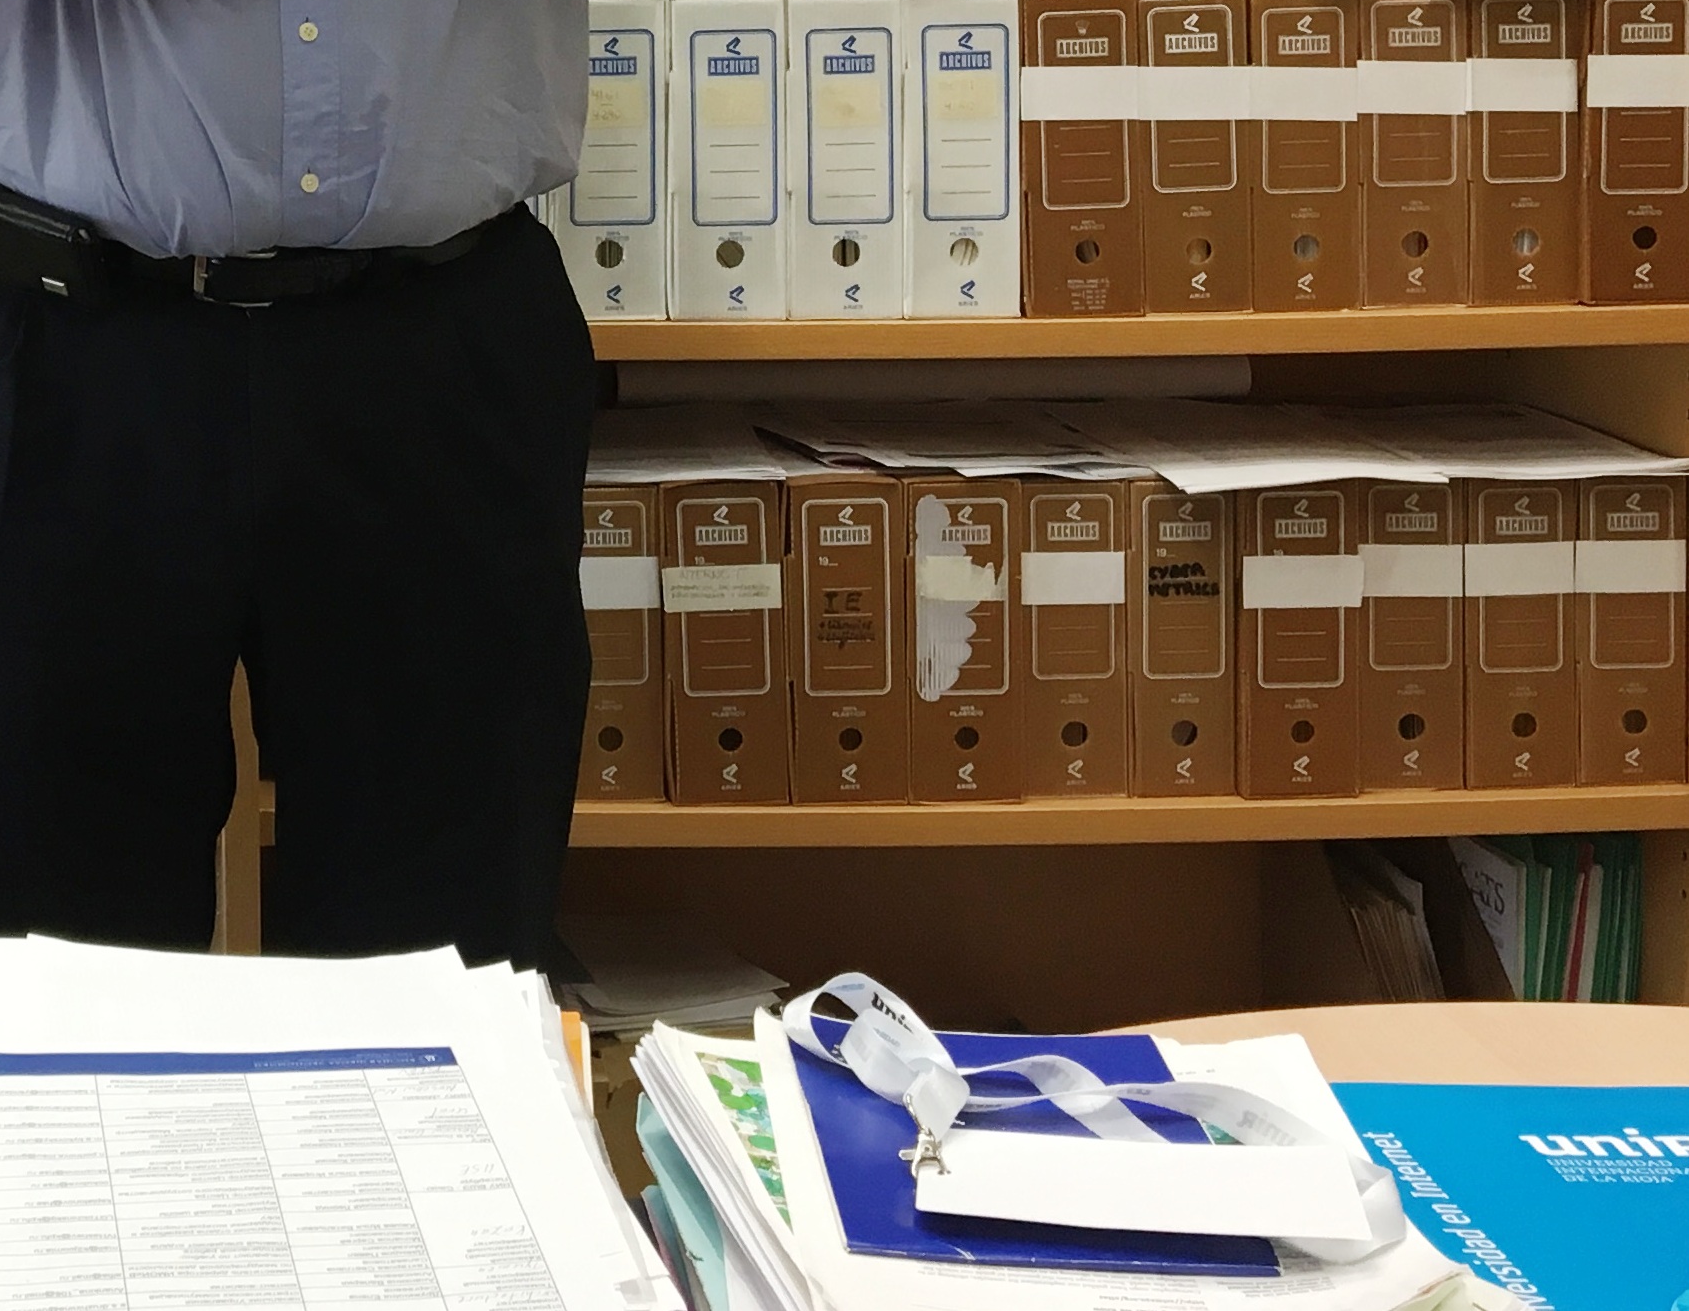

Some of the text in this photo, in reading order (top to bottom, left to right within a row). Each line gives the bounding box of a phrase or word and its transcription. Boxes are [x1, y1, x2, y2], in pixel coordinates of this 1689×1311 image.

[1392, 28, 1438, 45] ARCHIVOS
[1624, 24, 1670, 41] ARCHIVOS
[1059, 39, 1106, 55] ARCHIVOS
[1168, 35, 1214, 51] ARCHIVOS
[826, 57, 872, 72] ARCHIVOS
[1278, 520, 1324, 536] ARCHIVOS
[1389, 514, 1435, 529] ARCHIVOS
[1609, 514, 1656, 529] ARCHIVOS
[698, 527, 745, 543] ARCHIVOS
[822, 527, 869, 543] ARCHIVOS
[1162, 523, 1208, 539] ARCHIVOS
[1147, 561, 1206, 579] CYBER
[1148, 582, 1220, 597] METRICS
[1362, 1131, 1450, 1200] Internet
[1546, 1158, 1673, 1168] UNIVERSIDAD
[1554, 1166, 1689, 1176] INTERNACIONA
[1561, 1174, 1675, 1184] DE LA RIOJA
[1431, 1202, 1556, 1311] versidad en
